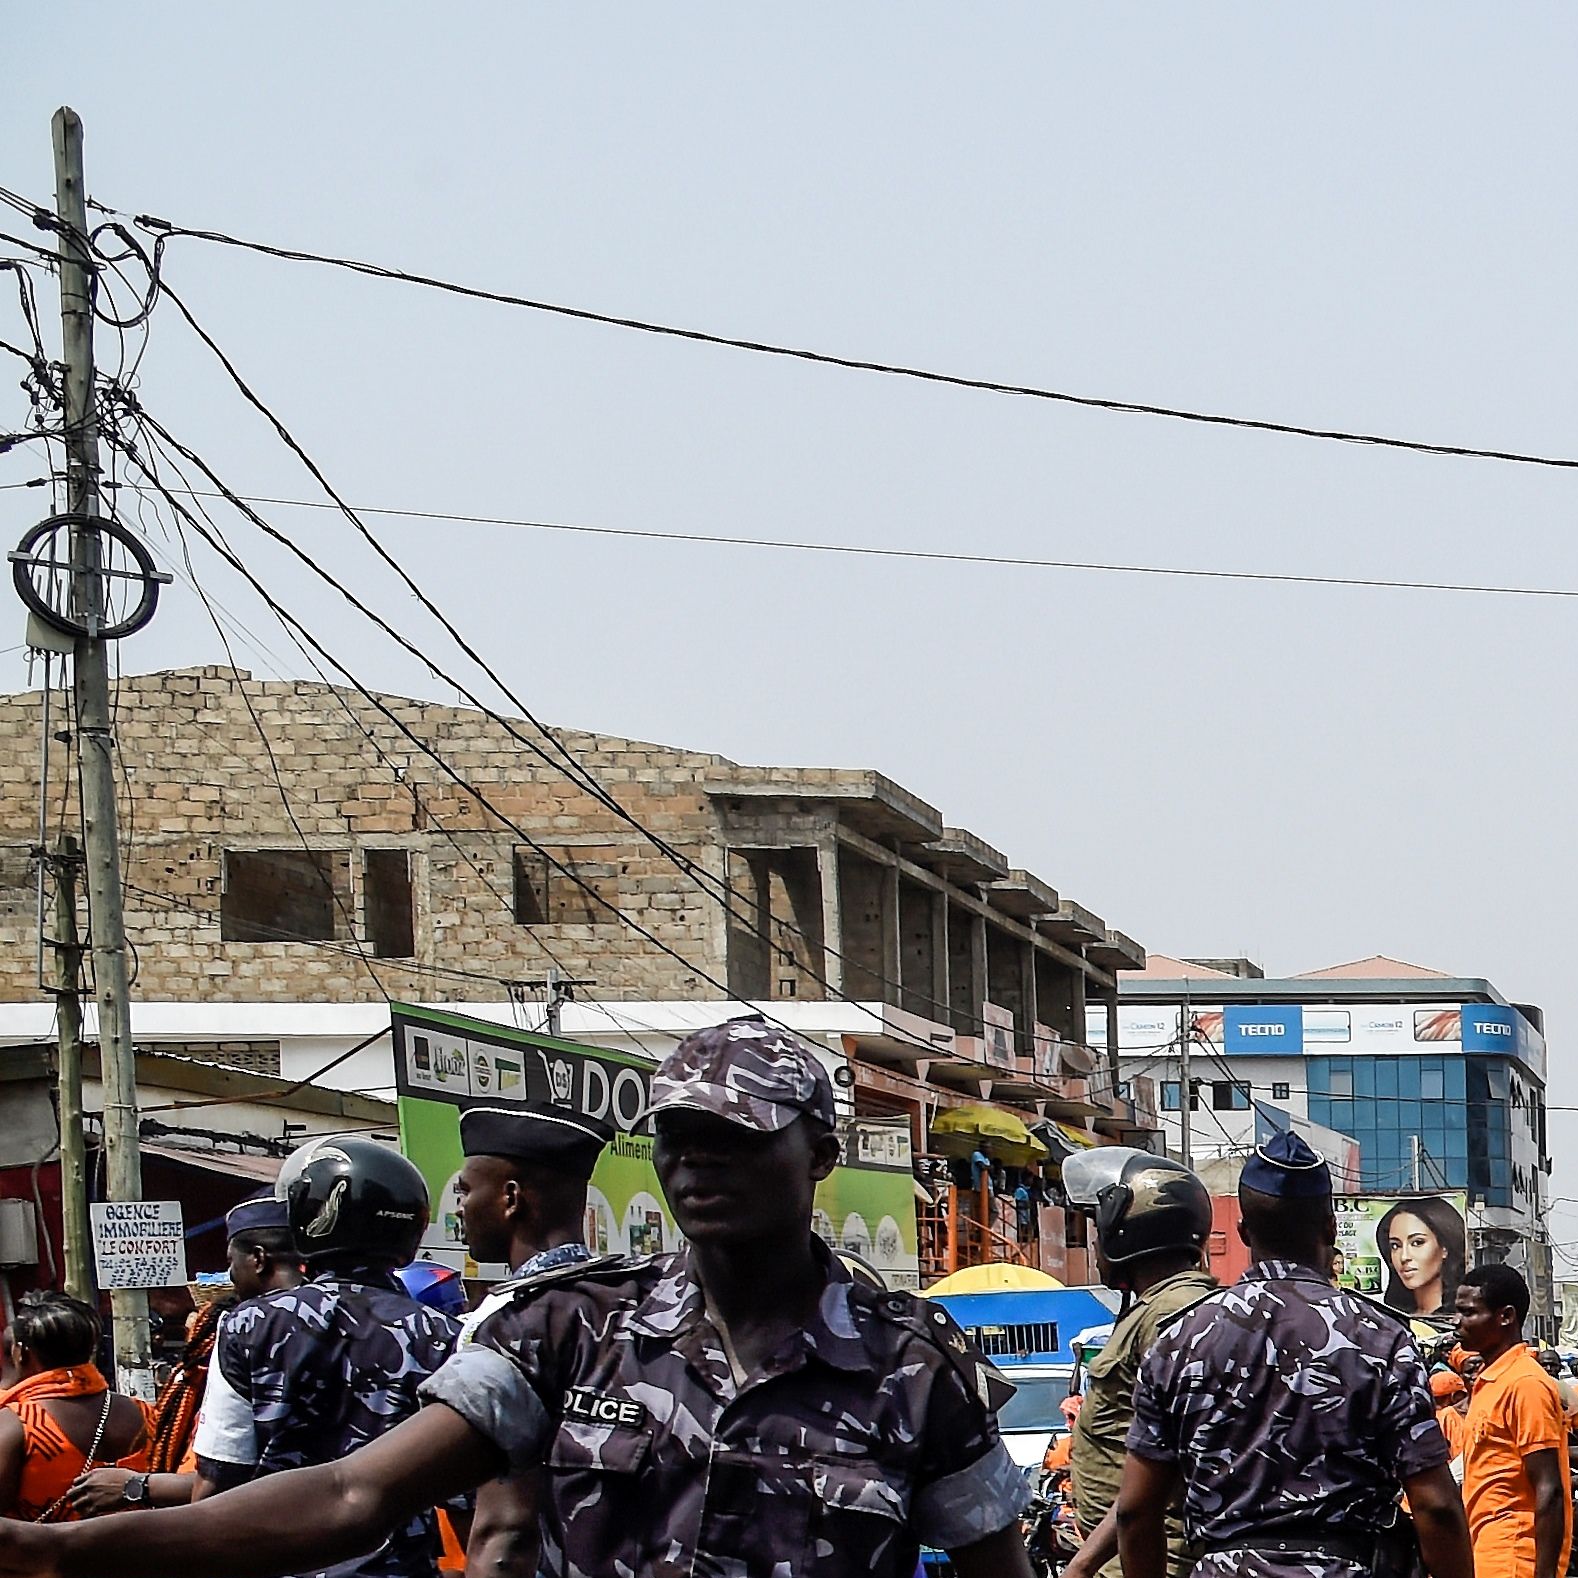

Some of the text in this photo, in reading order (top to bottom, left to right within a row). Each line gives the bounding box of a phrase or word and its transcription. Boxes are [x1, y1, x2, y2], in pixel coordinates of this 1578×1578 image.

[1238, 1024, 1285, 1036] TECNO
[1473, 1022, 1511, 1036] TECNO
[582, 1060, 657, 1134] DO
[610, 1134, 653, 1160] Aliment
[105, 1204, 160, 1221] AGENCE
[119, 1240, 178, 1255] CONFORT
[564, 1390, 640, 1423] OLICE
